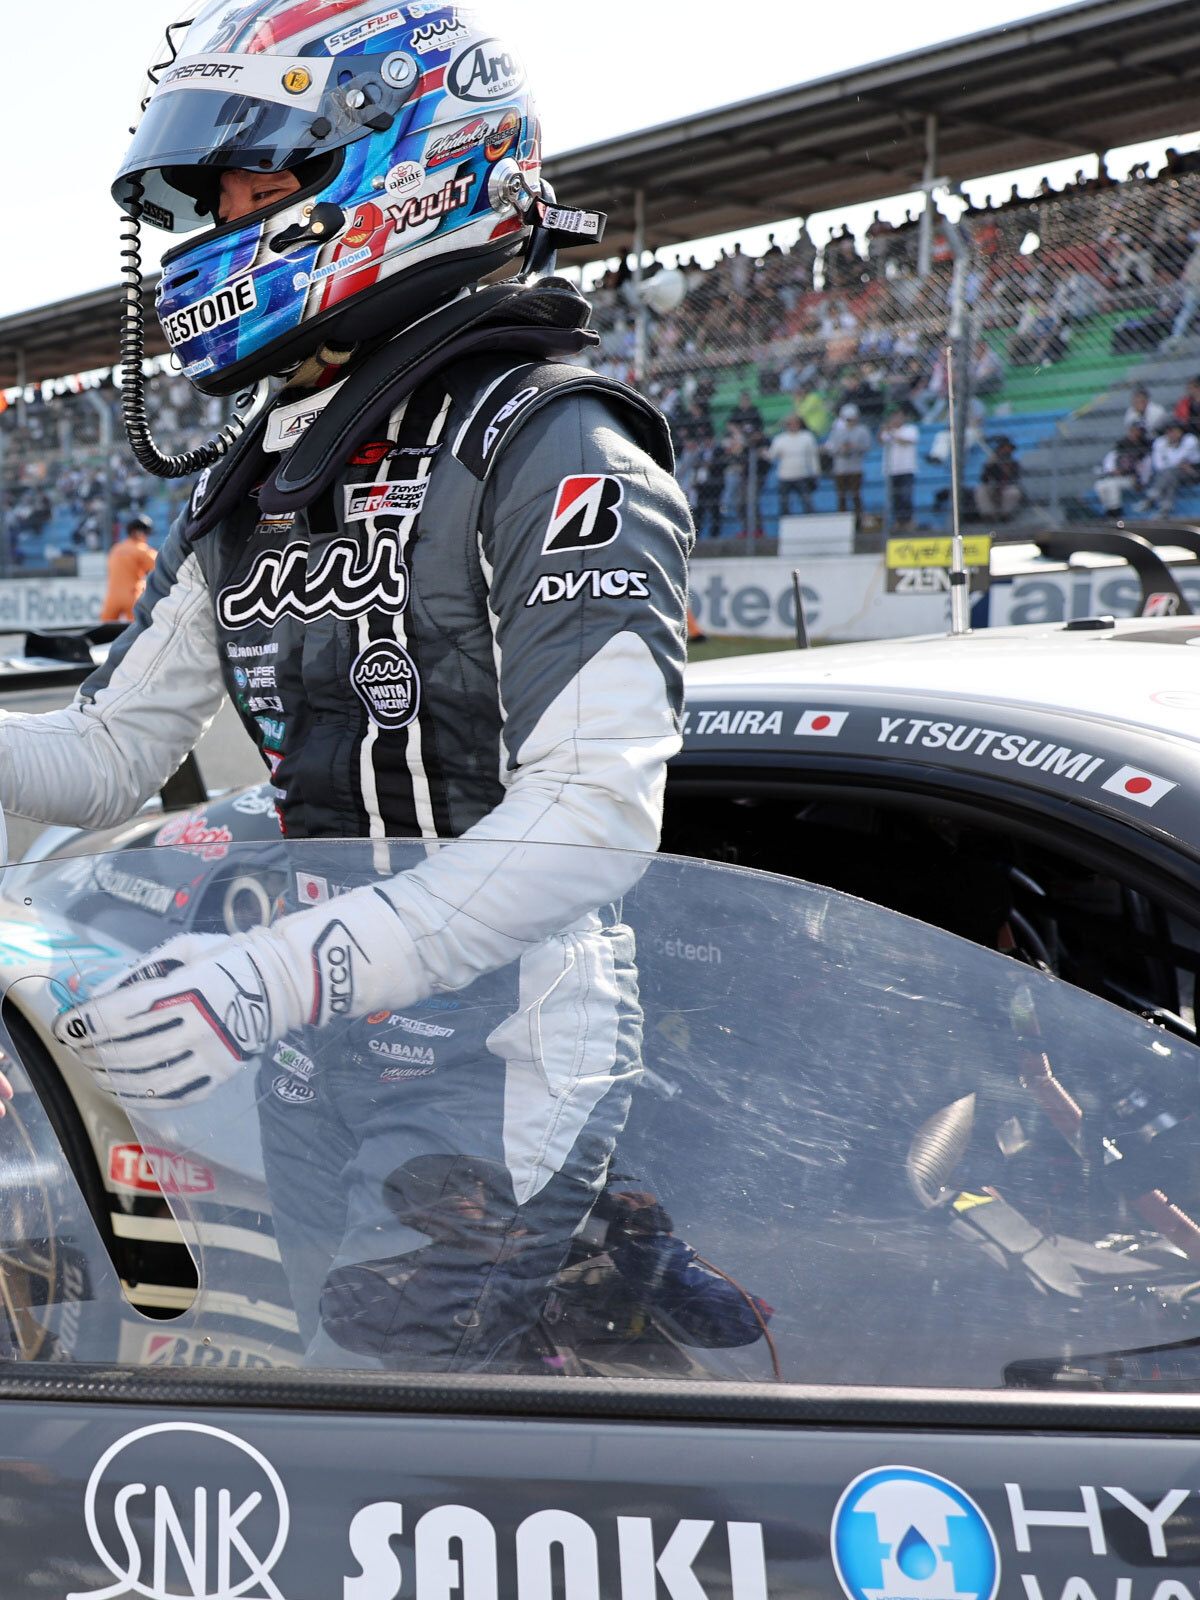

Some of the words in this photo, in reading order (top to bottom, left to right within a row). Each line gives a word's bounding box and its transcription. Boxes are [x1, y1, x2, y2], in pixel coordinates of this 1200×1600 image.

[390, 170, 423, 190] BRIDE
[583, 219, 597, 228] 2023
[311, 262, 337, 281] SANKI
[336, 247, 370, 272] SHOKAI
[525, 569, 650, 607] ADVICS
[894, 567, 981, 595] ZEN
[690, 575, 821, 629] tec
[371, 683, 407, 699] MUTA
[373, 698, 410, 711] RACING
[683, 710, 784, 736] .TAIRA
[877, 717, 1105, 783] Y.TSUTSUMI
[368, 1039, 435, 1063] CABANA
[118, 1150, 209, 1188] TONE
